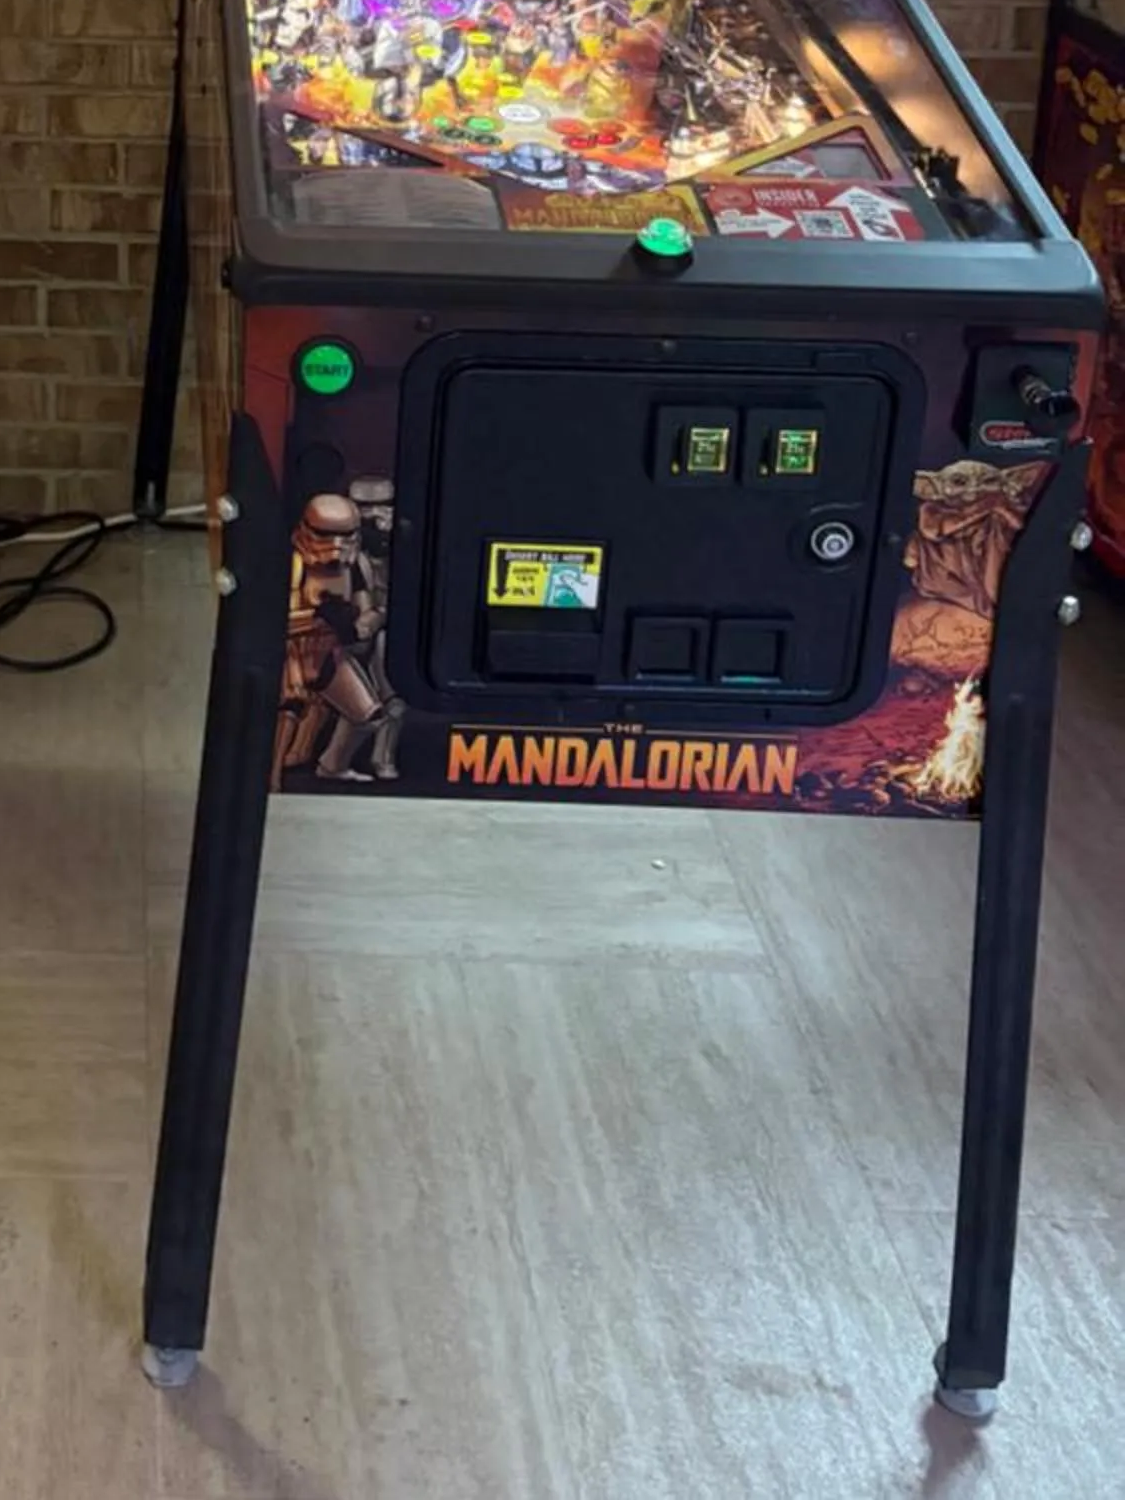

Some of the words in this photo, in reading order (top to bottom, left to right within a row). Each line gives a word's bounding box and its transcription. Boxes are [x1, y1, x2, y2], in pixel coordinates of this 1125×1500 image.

[305, 363, 350, 378] START
[603, 722, 645, 735] THE
[447, 733, 798, 796] MANDALORIAN
